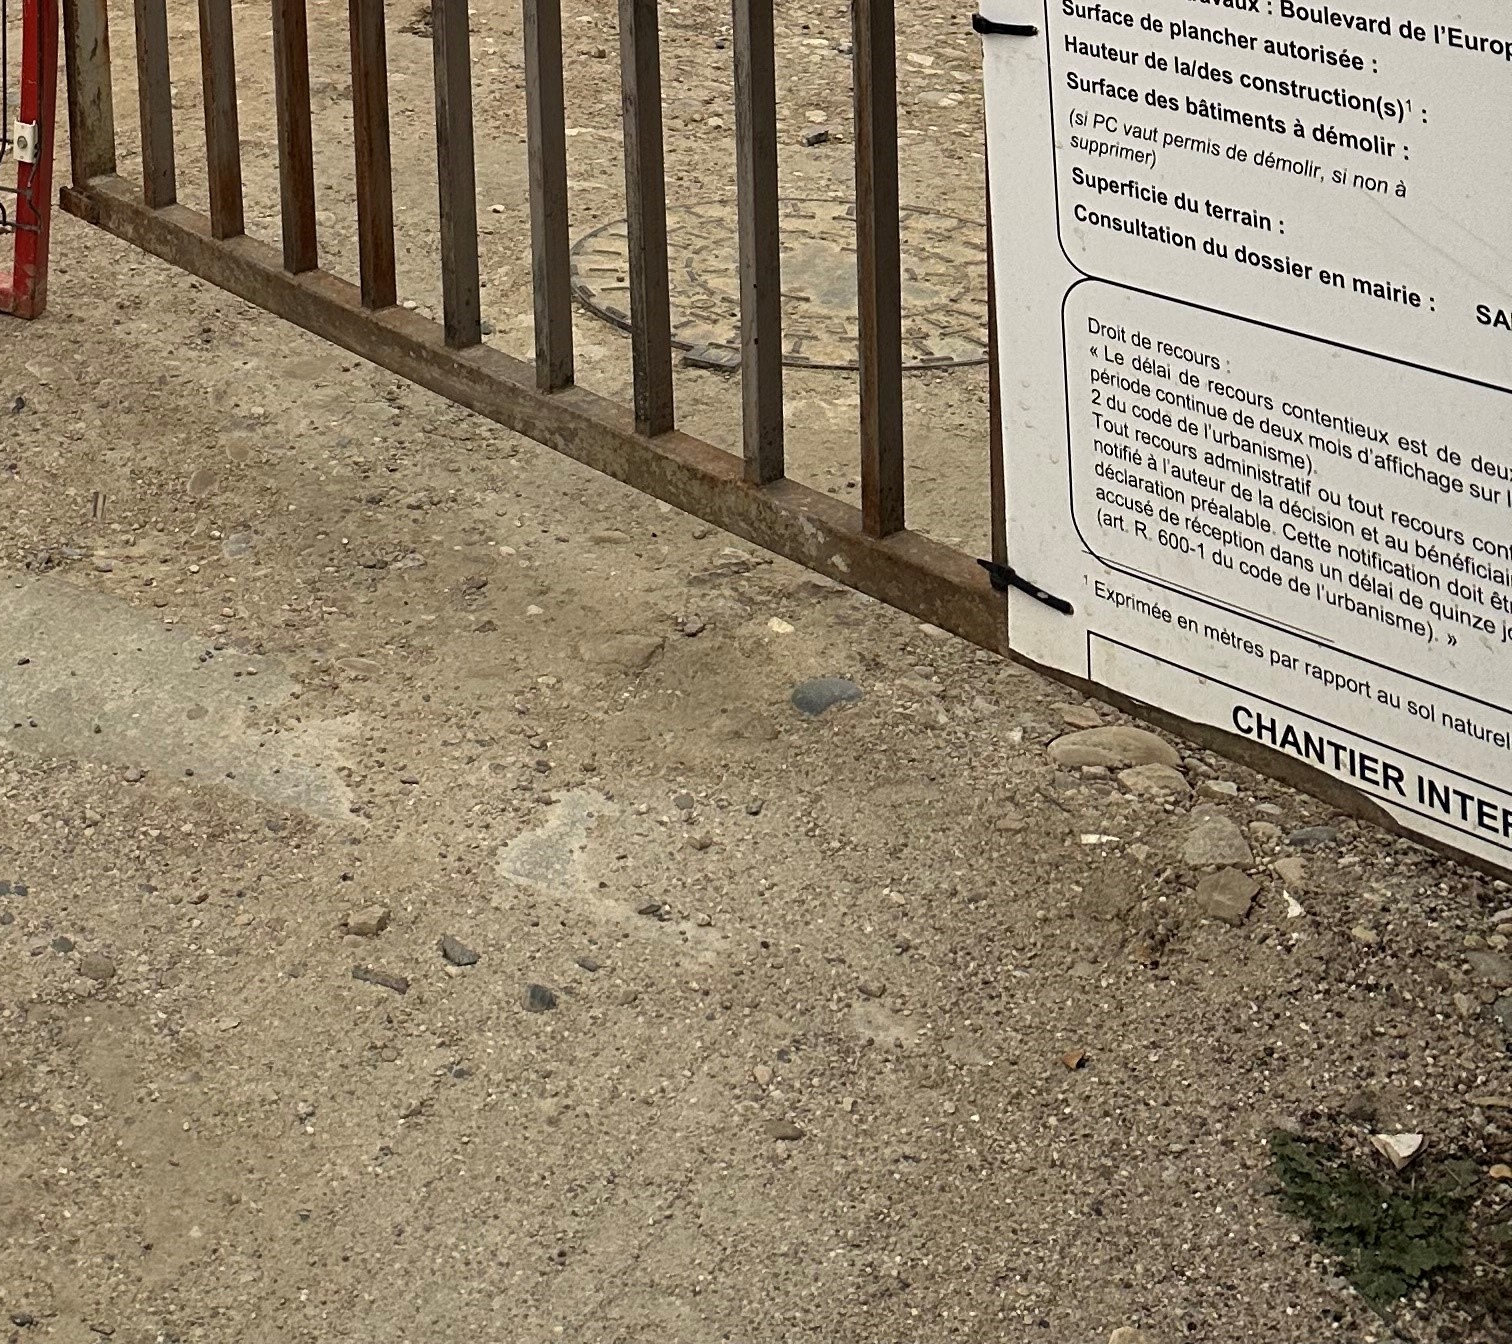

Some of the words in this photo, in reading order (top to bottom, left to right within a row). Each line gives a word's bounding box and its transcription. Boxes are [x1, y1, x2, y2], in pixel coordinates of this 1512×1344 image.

[1139, 12, 1164, 33] de
[1169, 19, 1258, 51] plancher
[1263, 39, 1364, 71] autorisée
[1232, 705, 1407, 798] CHANTIER
